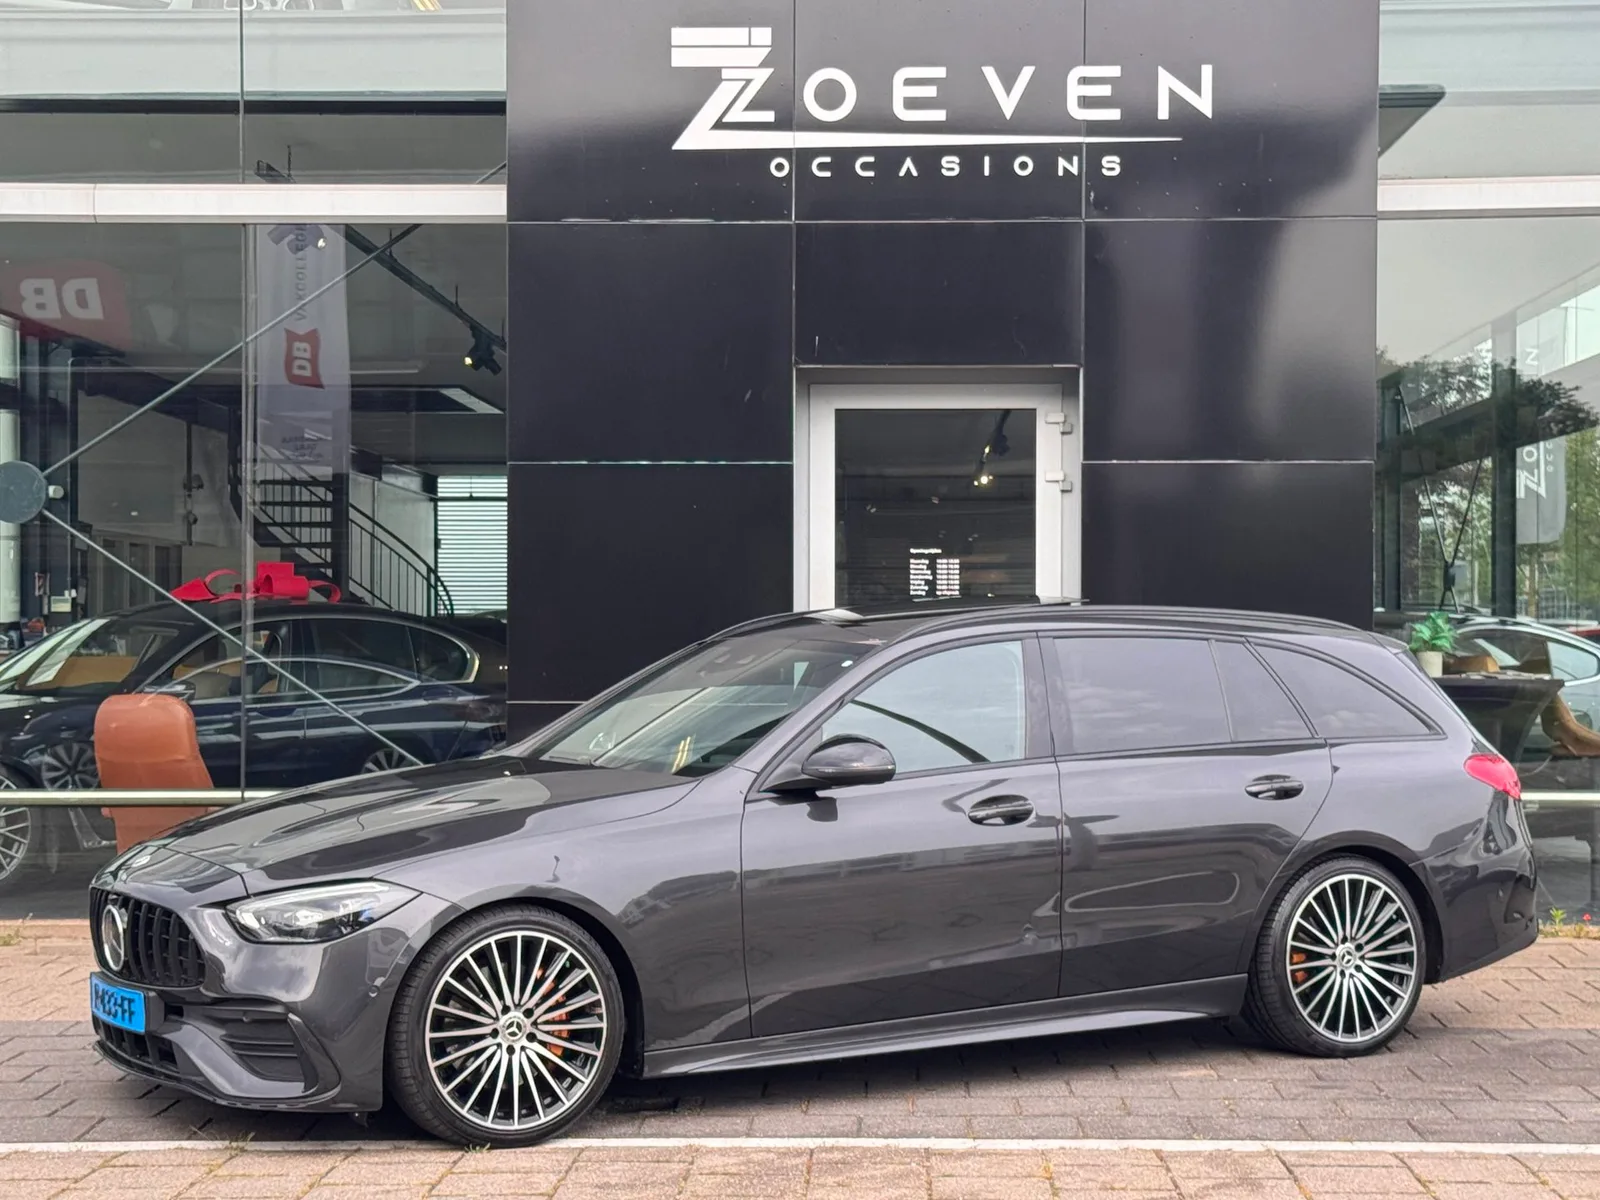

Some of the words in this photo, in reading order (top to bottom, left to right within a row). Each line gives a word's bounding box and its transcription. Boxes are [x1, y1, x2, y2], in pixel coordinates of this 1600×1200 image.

[671, 27, 1213, 150] ZOEVEN
[769, 156, 1122, 178] OCCASIONS
[291, 341, 313, 377] DB
